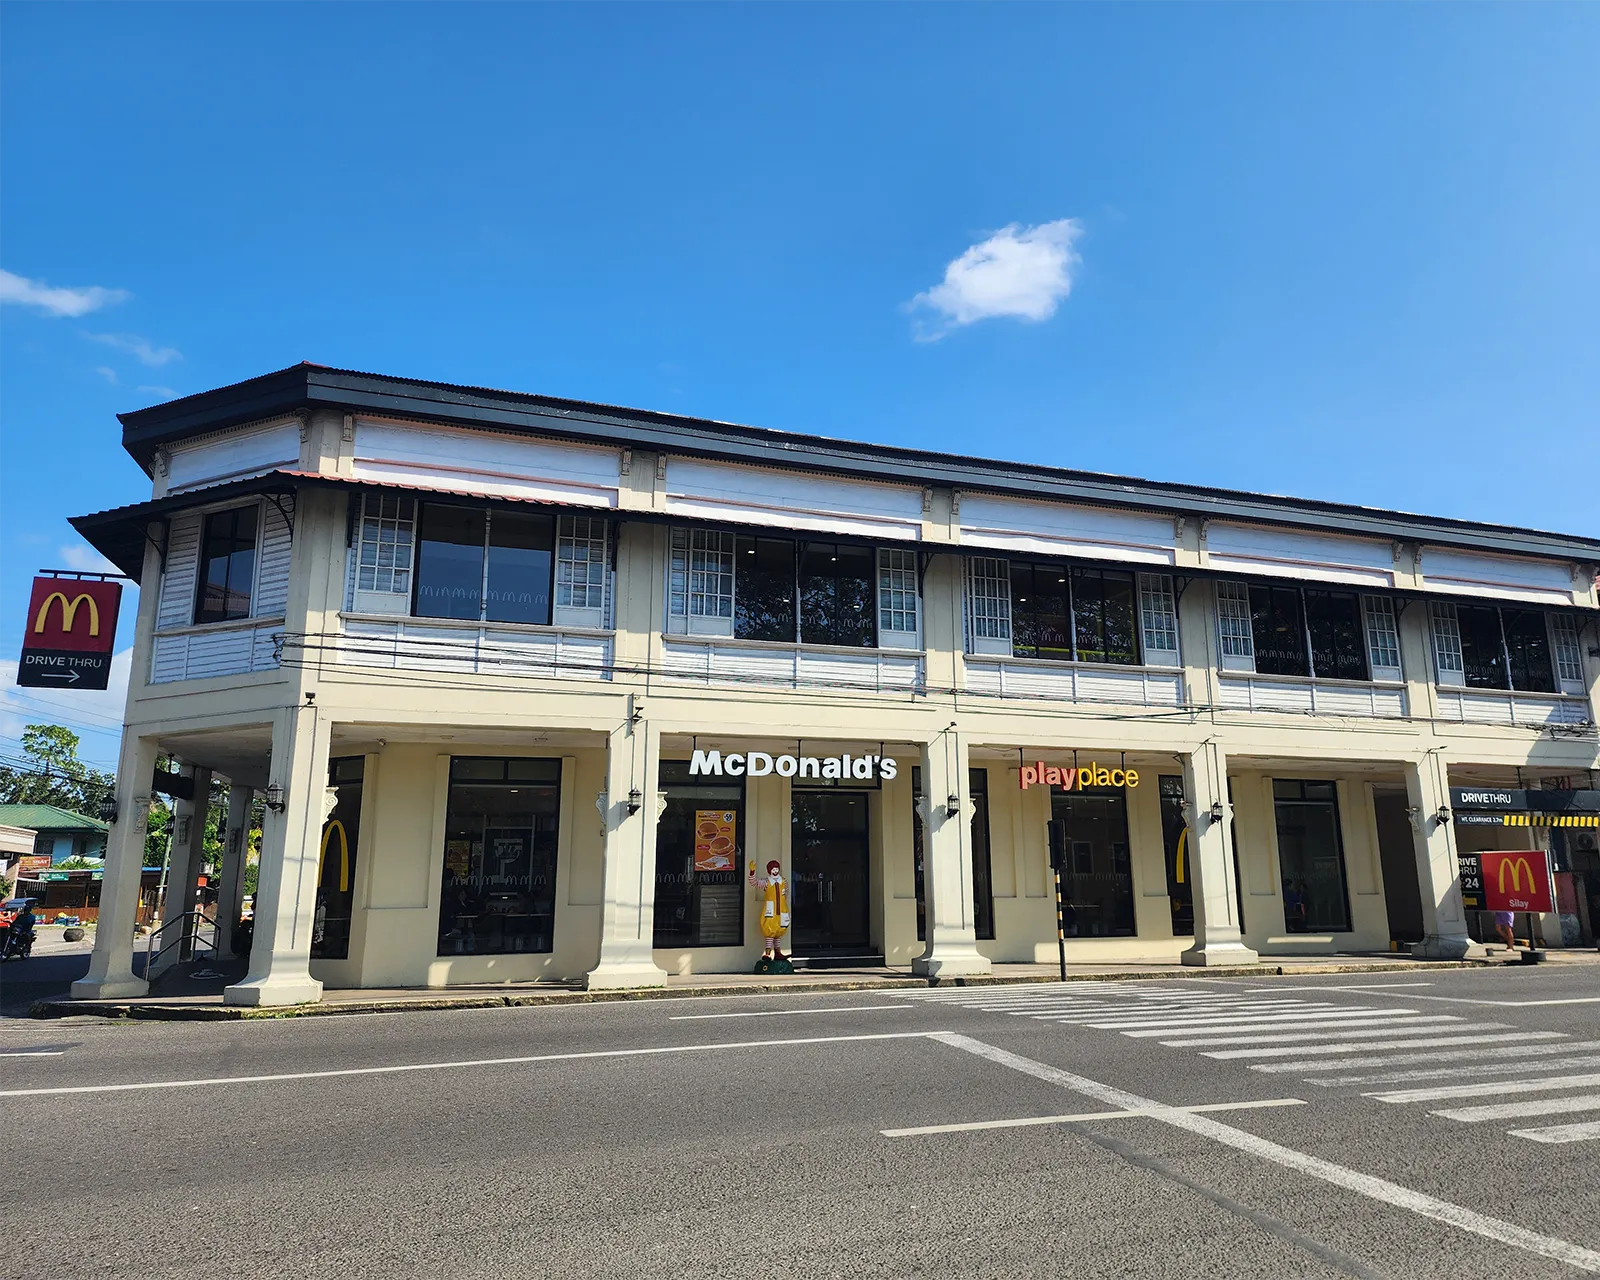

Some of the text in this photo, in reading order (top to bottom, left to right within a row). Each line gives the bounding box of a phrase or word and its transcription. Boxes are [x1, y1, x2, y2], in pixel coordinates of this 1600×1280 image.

[25, 655, 102, 668] DRIVE THRU
[689, 749, 898, 780] McDonald's
[1457, 857, 1477, 866] RIVE
[1459, 867, 1477, 875] HRU
[1509, 899, 1529, 909] Silay
